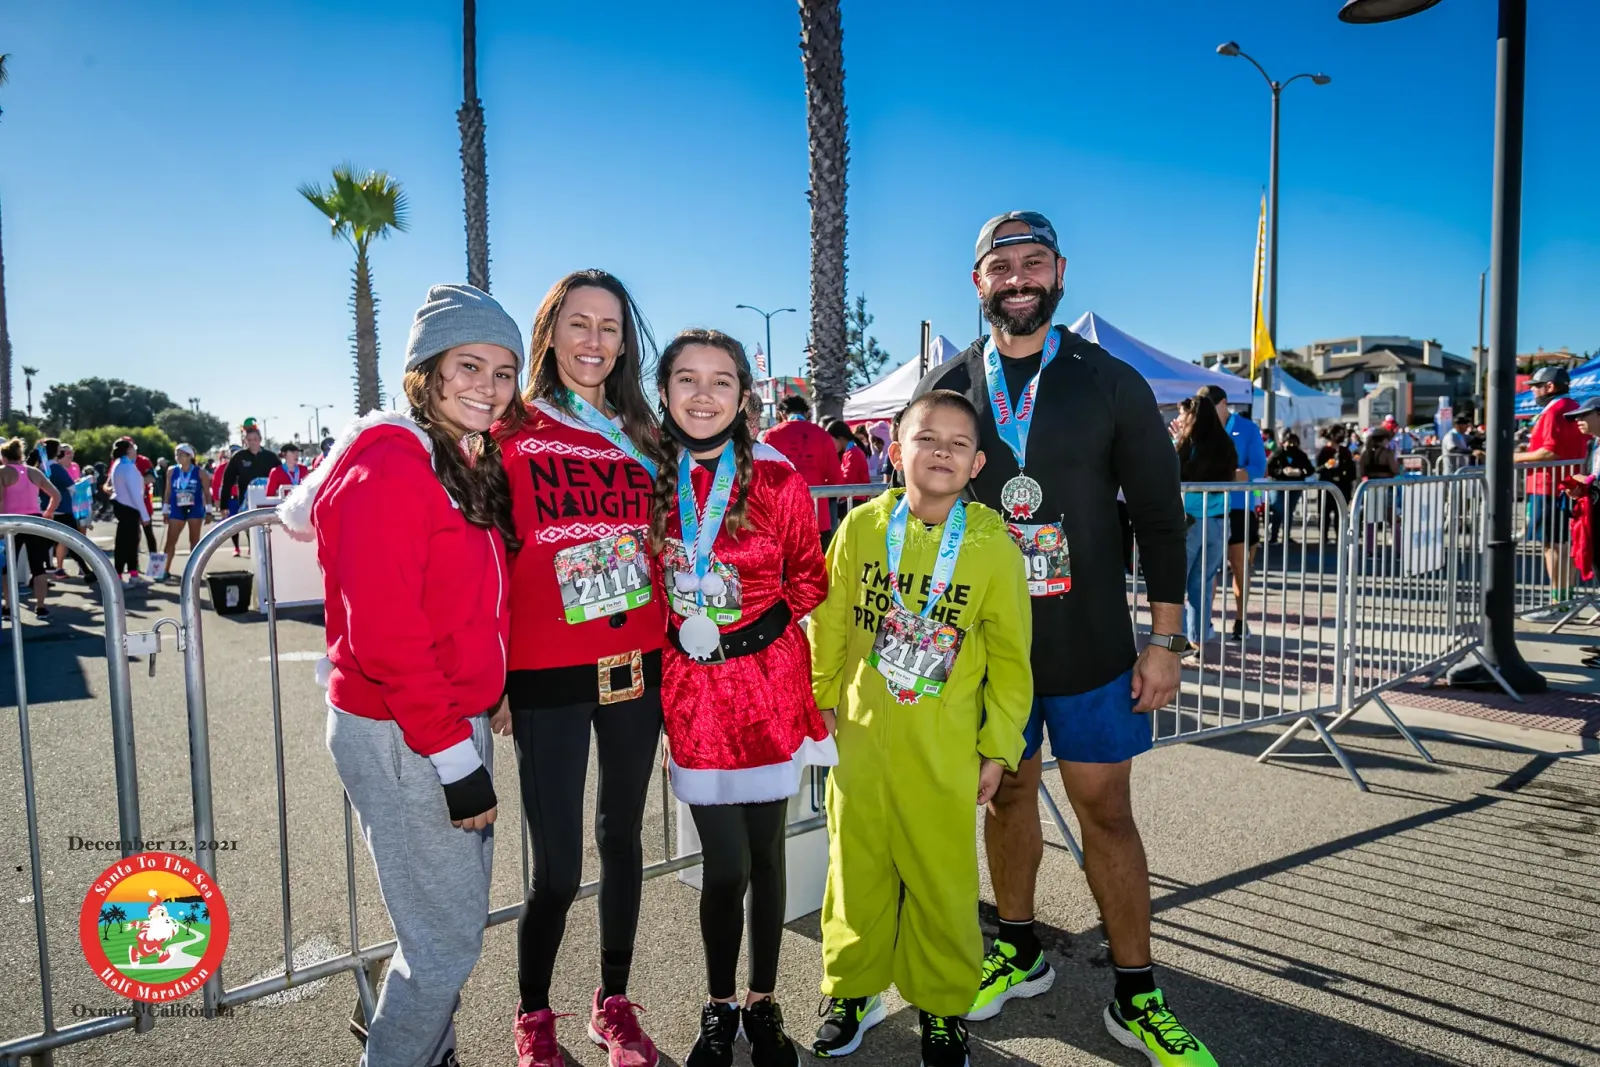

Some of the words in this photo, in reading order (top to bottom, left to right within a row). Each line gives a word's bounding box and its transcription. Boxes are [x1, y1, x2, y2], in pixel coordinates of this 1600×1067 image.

[528, 456, 649, 491] NEVE
[941, 532, 960, 559] Sea
[575, 563, 641, 605] 2114
[865, 589, 894, 612] FO
[917, 600, 961, 628] THE
[880, 634, 944, 678] 2117
